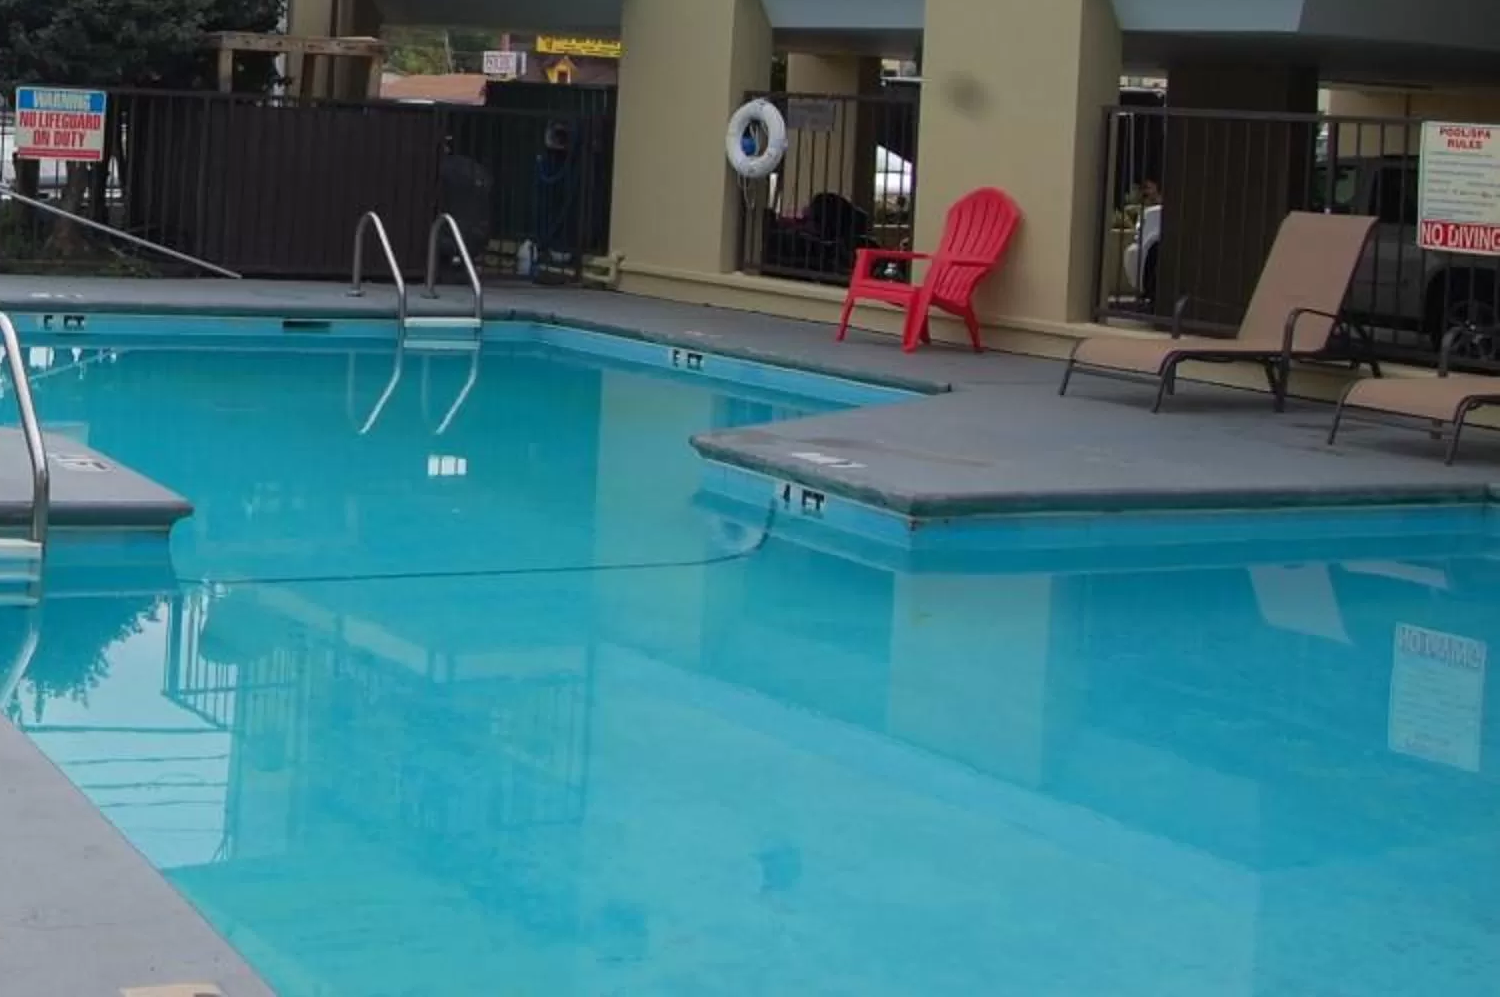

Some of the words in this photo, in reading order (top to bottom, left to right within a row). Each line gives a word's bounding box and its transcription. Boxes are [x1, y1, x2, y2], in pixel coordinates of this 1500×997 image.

[19, 111, 37, 128] NO
[39, 112, 101, 131] LIFEGUARD
[34, 130, 49, 145] ON
[54, 130, 85, 148] DUTY
[1447, 138, 1483, 151] RULES
[1421, 221, 1443, 246] NO
[1446, 223, 1500, 251] DIVING
